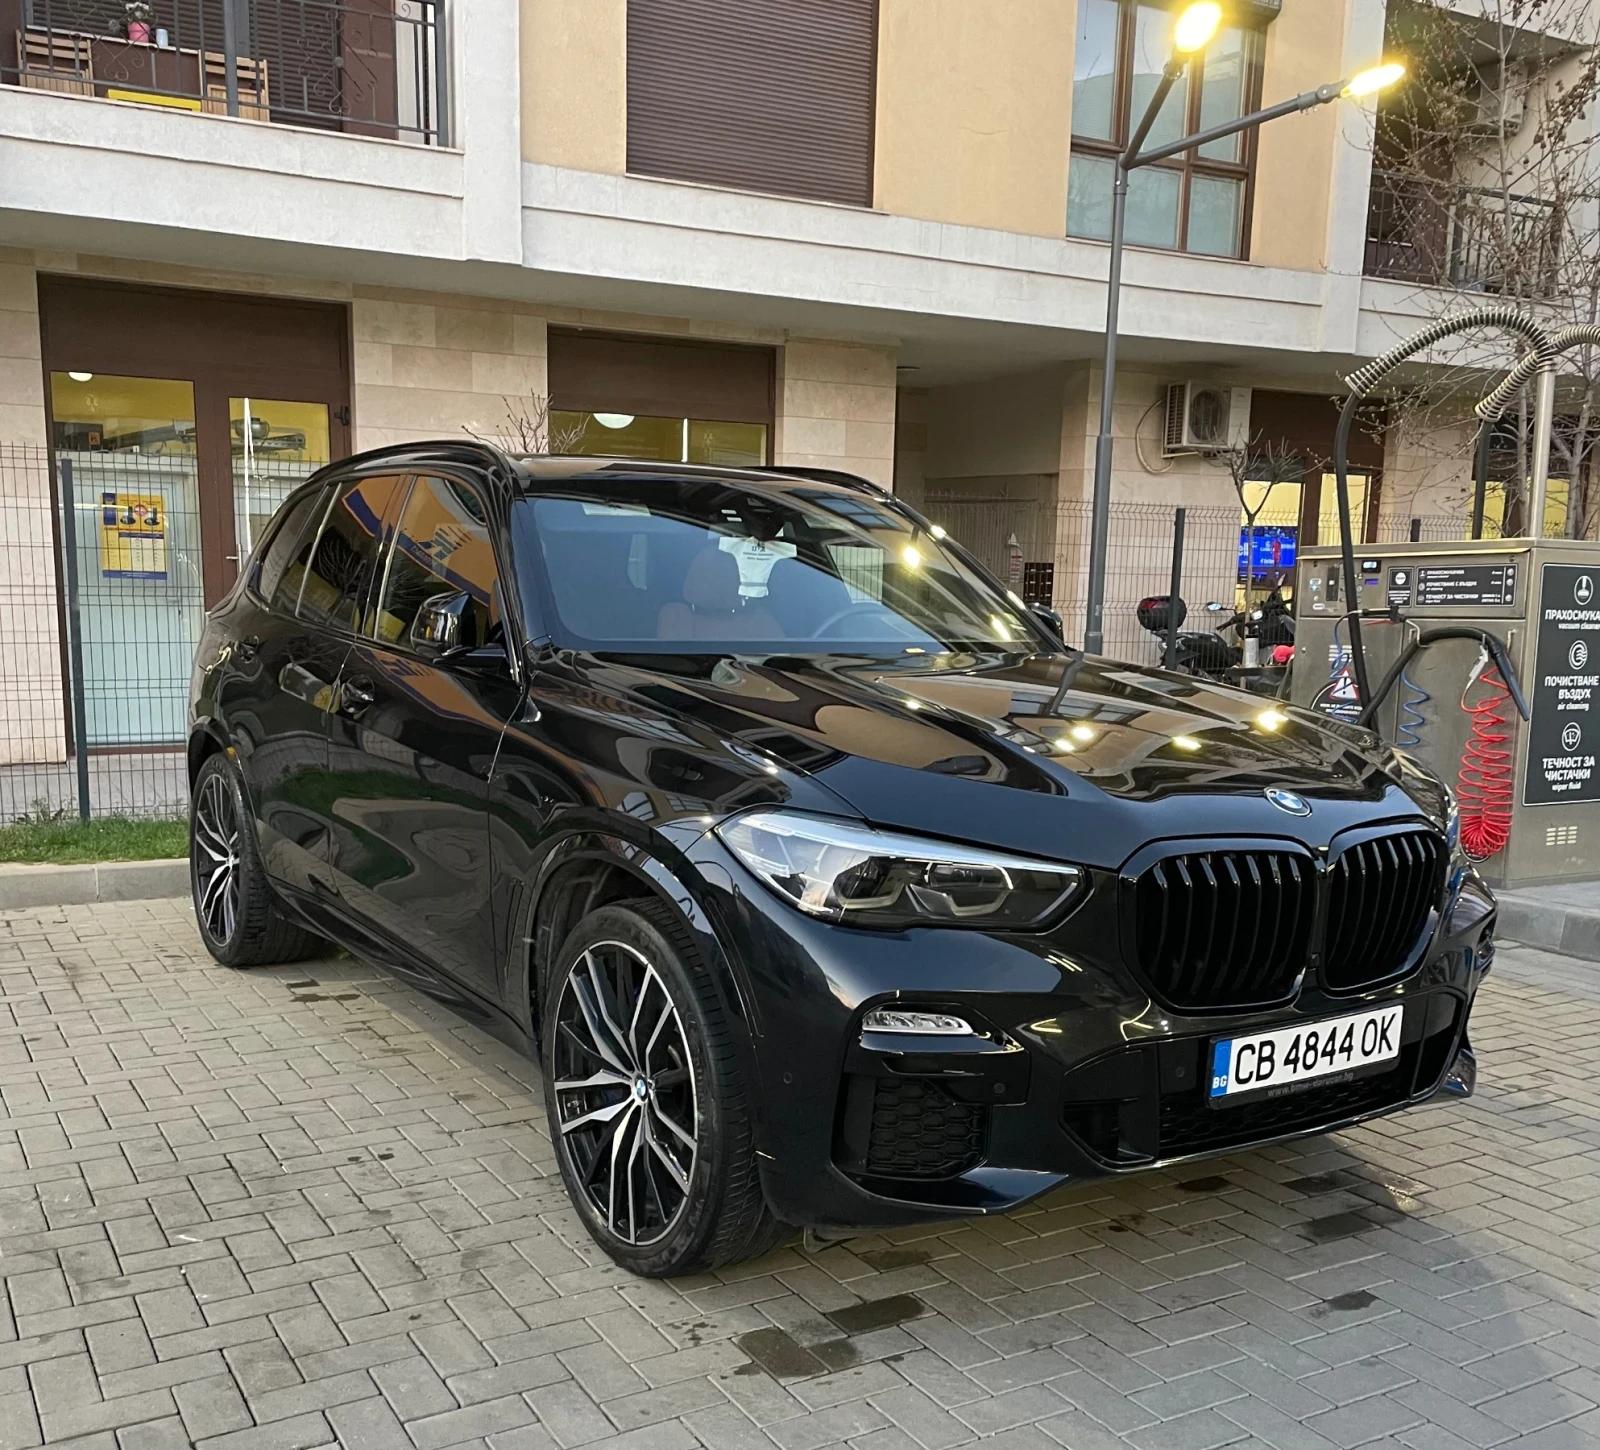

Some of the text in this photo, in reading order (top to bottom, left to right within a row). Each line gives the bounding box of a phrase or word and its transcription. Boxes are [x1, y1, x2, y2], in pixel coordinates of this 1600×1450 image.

[1544, 675, 1600, 687] ПОЧИСТВАНЕ
[1558, 688, 1592, 700] ВЪЗДУХ
[1557, 702, 1590, 711] air cleaning
[1542, 755, 1596, 769] ТЕЧНОСТ ЗА
[1544, 768, 1592, 781] ЧИСТАЧКИ
[1552, 781, 1582, 792] wiper fluid
[1234, 1012, 1397, 1086] CB 4844 OK
[1212, 1074, 1228, 1089] BG
